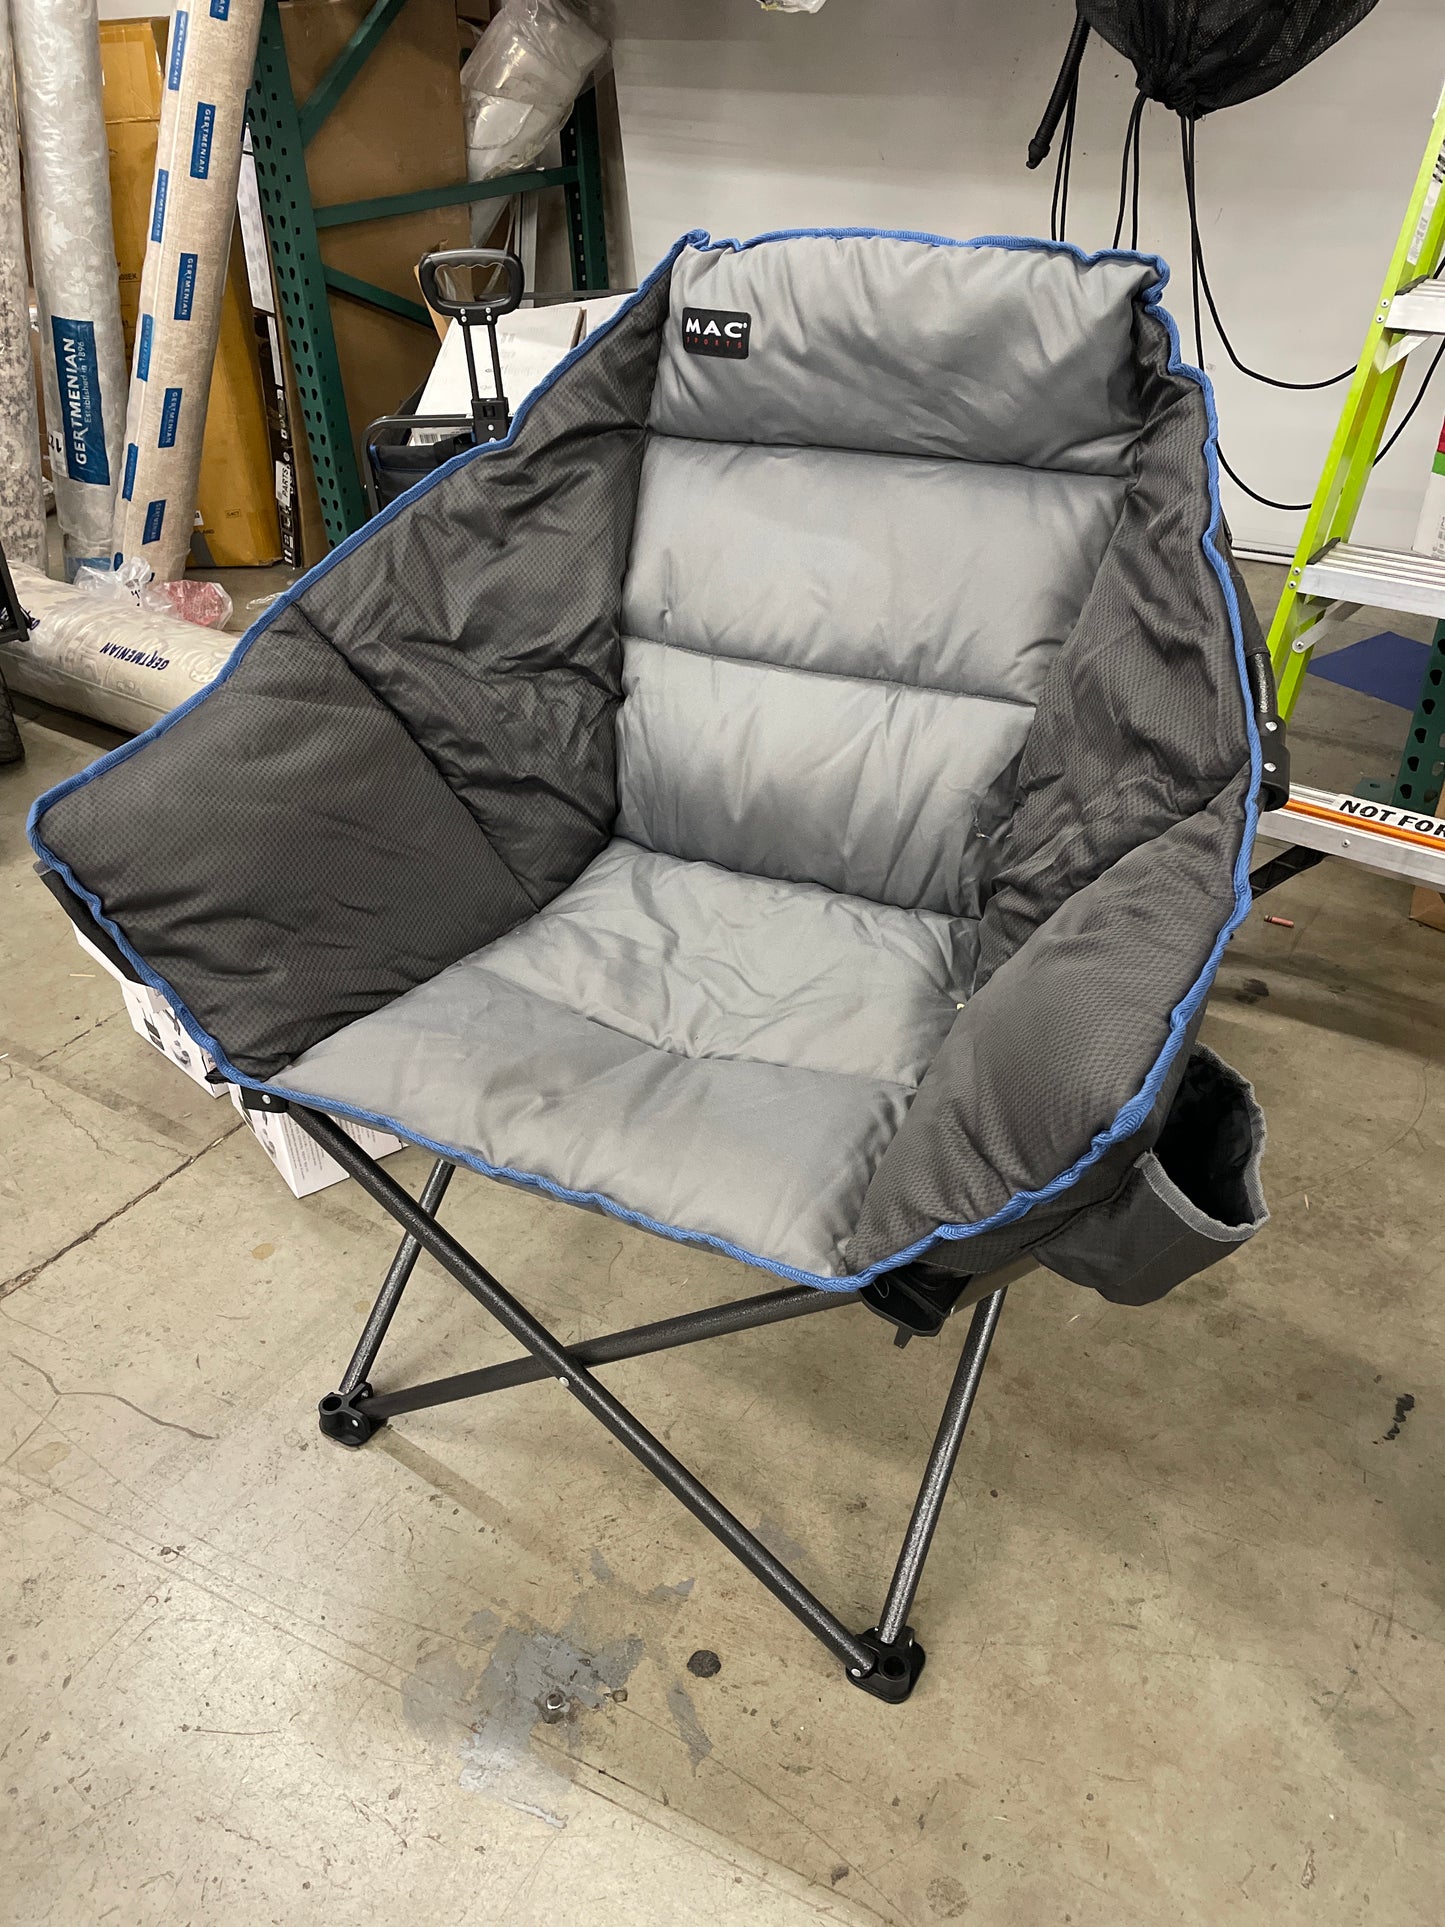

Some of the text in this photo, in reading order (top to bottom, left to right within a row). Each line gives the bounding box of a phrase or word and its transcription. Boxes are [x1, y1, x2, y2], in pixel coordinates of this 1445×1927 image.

[198, 108, 211, 173] GERTMENIAN
[181, 258, 194, 315] GERTMENIAN
[685, 317, 744, 338] MAC
[62, 338, 88, 465] GERTMENIAN
[77, 341, 92, 423] Established in 1896
[165, 391, 178, 444] GERTMENIAN
[281, 467, 290, 498] PARTS
[100, 642, 170, 671] GERTMENIAN
[1339, 800, 1397, 823] NOT
